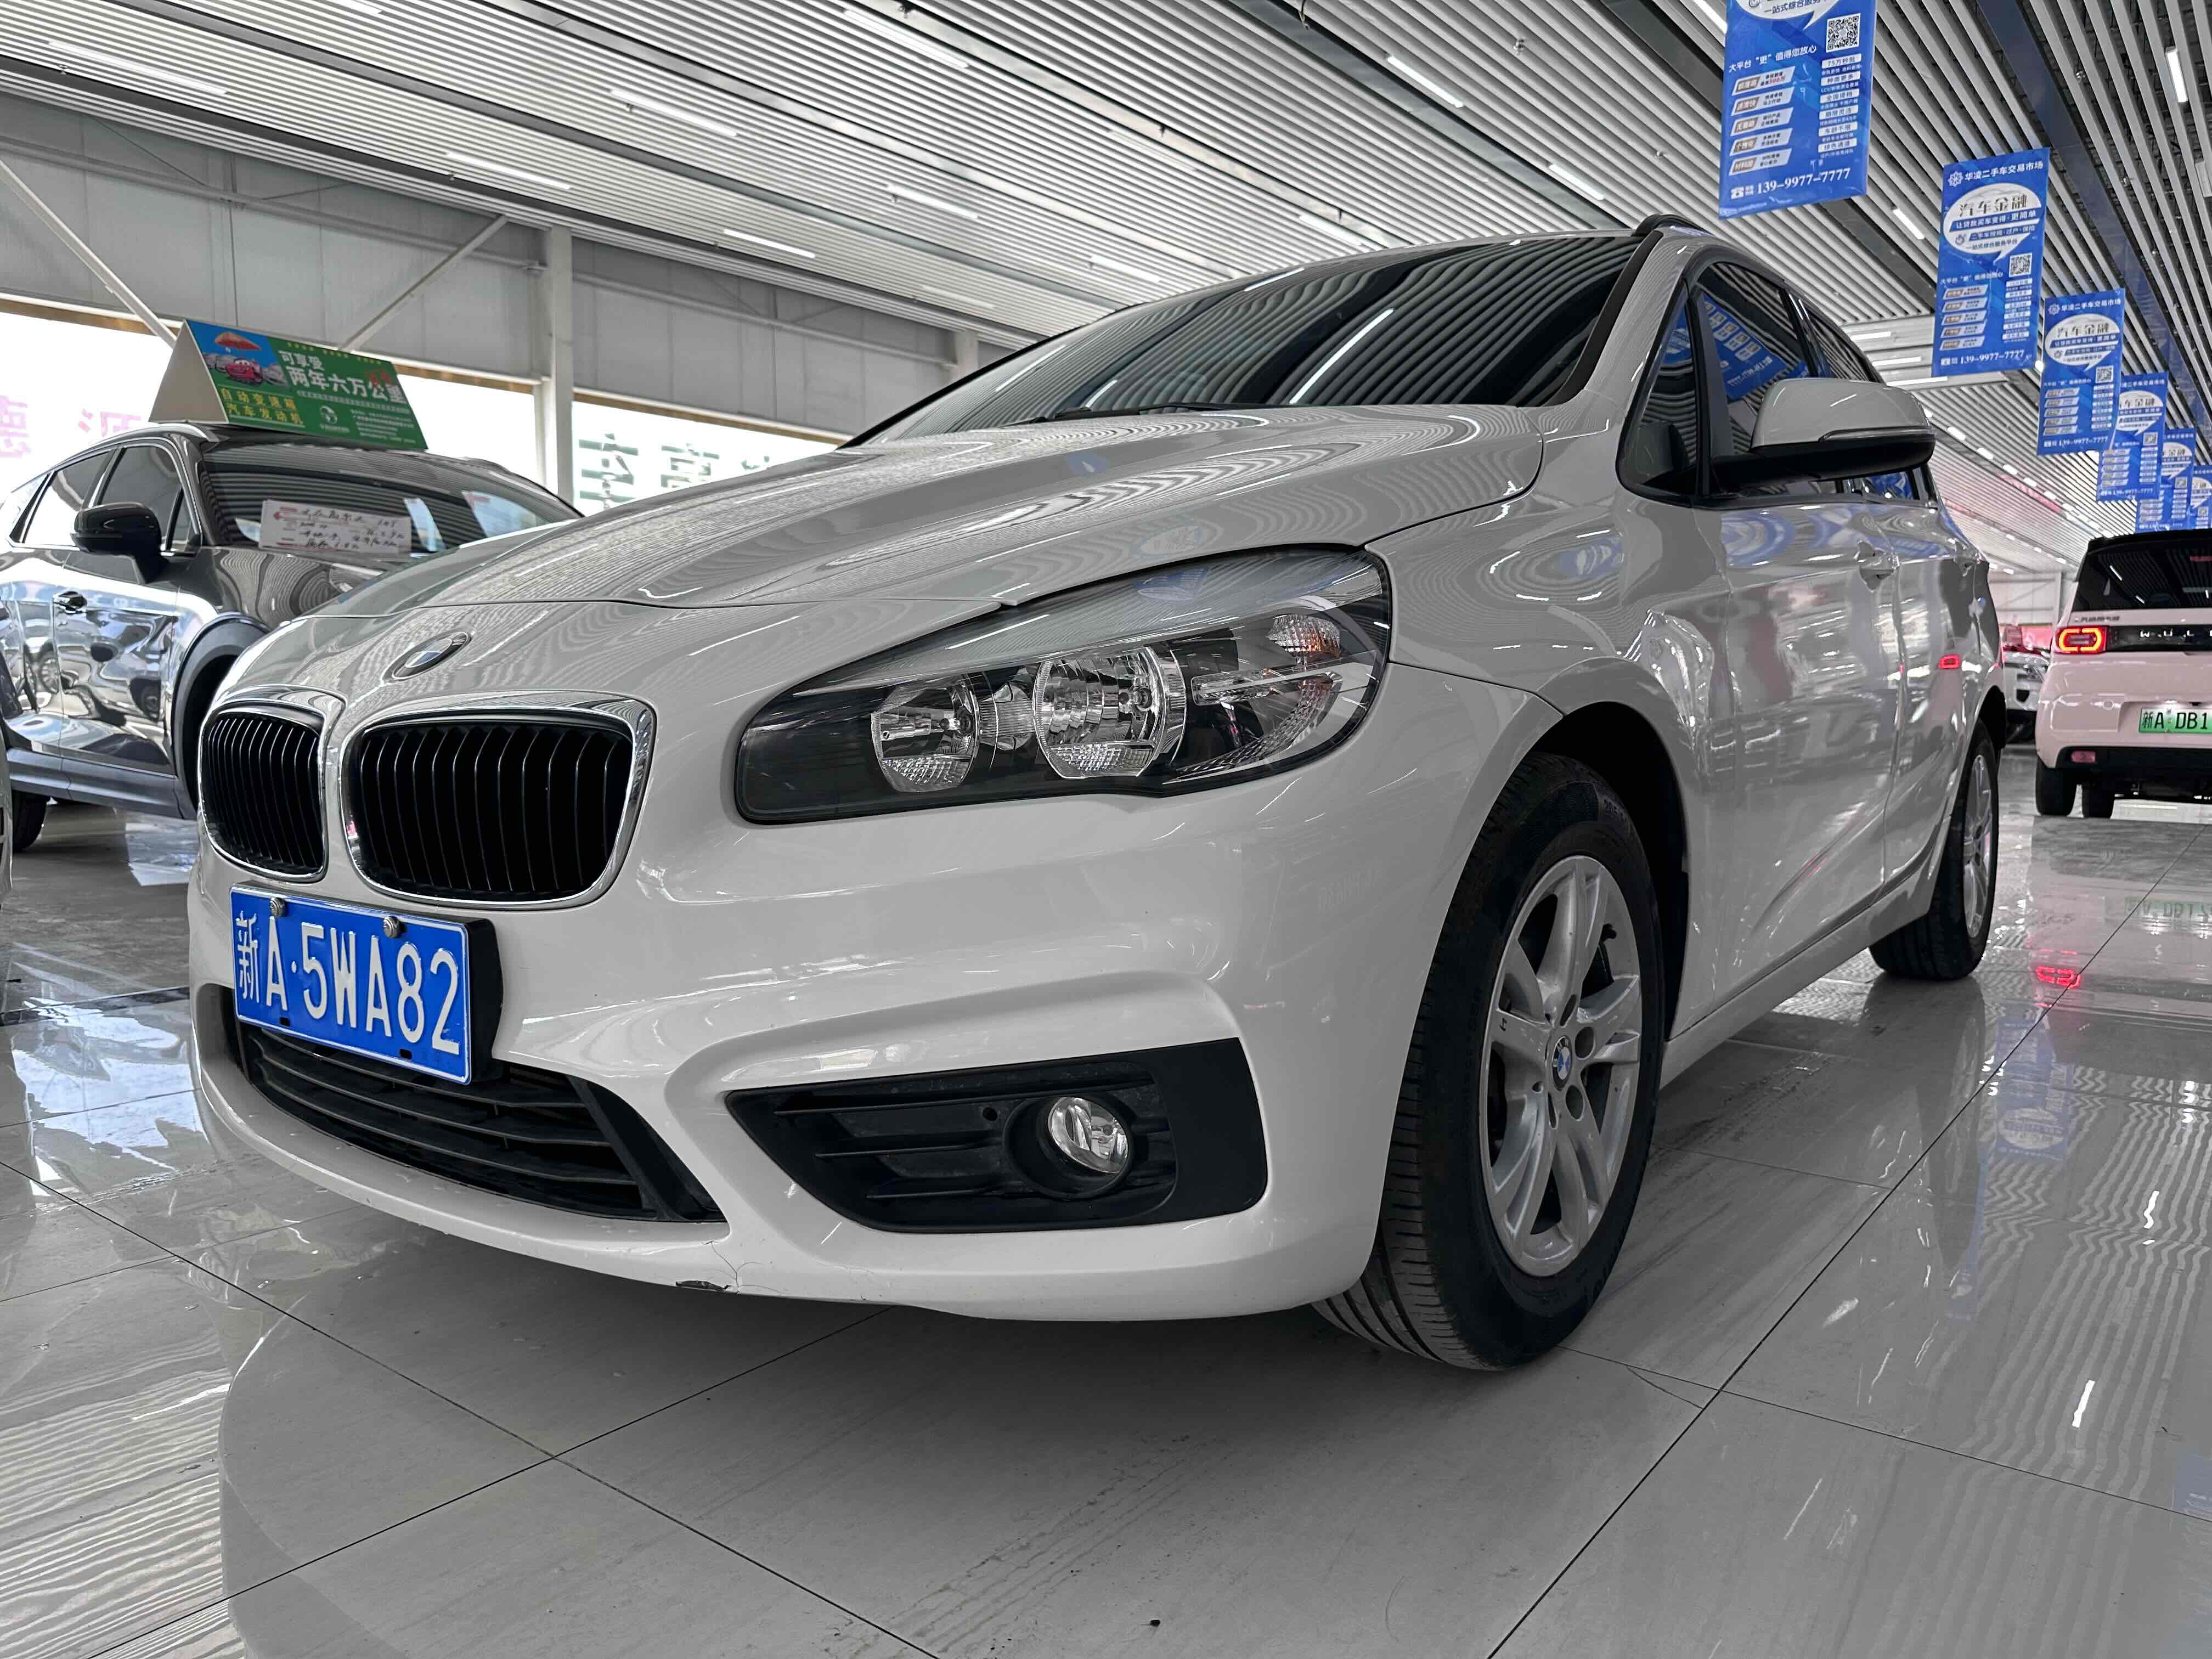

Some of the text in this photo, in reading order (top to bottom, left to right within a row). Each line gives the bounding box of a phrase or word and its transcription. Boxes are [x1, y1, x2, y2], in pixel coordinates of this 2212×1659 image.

[1729, 60, 1752, 74] 大平台
[1757, 167, 1852, 195] 139-9977-7777
[1965, 161, 2044, 181] 华凌二手车交易市场
[1959, 193, 2028, 217] 汽车金融
[278, 350, 325, 371] 可享受
[285, 366, 409, 404] 两年六万公里
[235, 909, 460, 1055] 新A·5WA82
